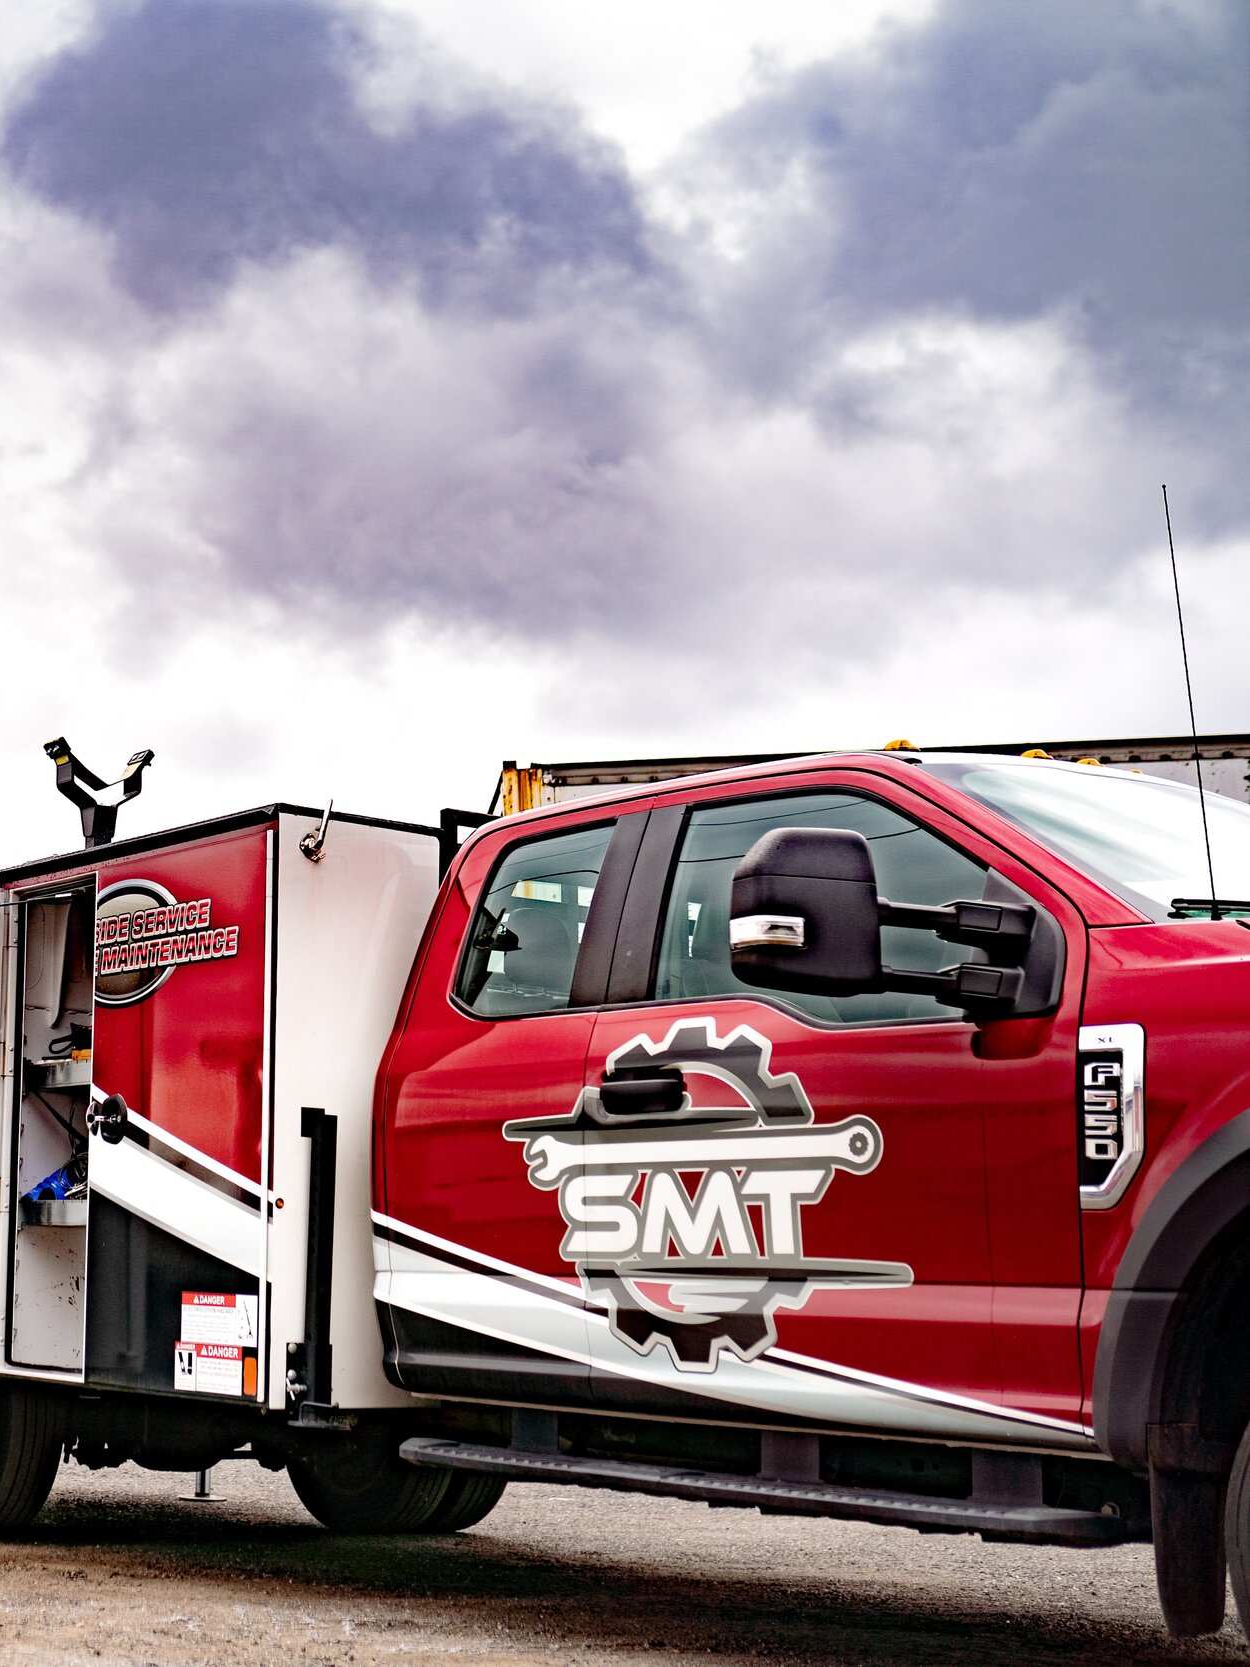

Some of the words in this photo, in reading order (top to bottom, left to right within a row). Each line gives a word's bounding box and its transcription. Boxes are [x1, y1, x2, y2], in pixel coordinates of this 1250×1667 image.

[132, 899, 211, 939] SERVICE
[101, 926, 239, 975] MAINTENANCE
[1084, 1062, 1121, 1160] F550
[565, 1169, 827, 1255] SMT
[199, 1295, 226, 1305] DANGER
[207, 1345, 239, 1358] DANGER
